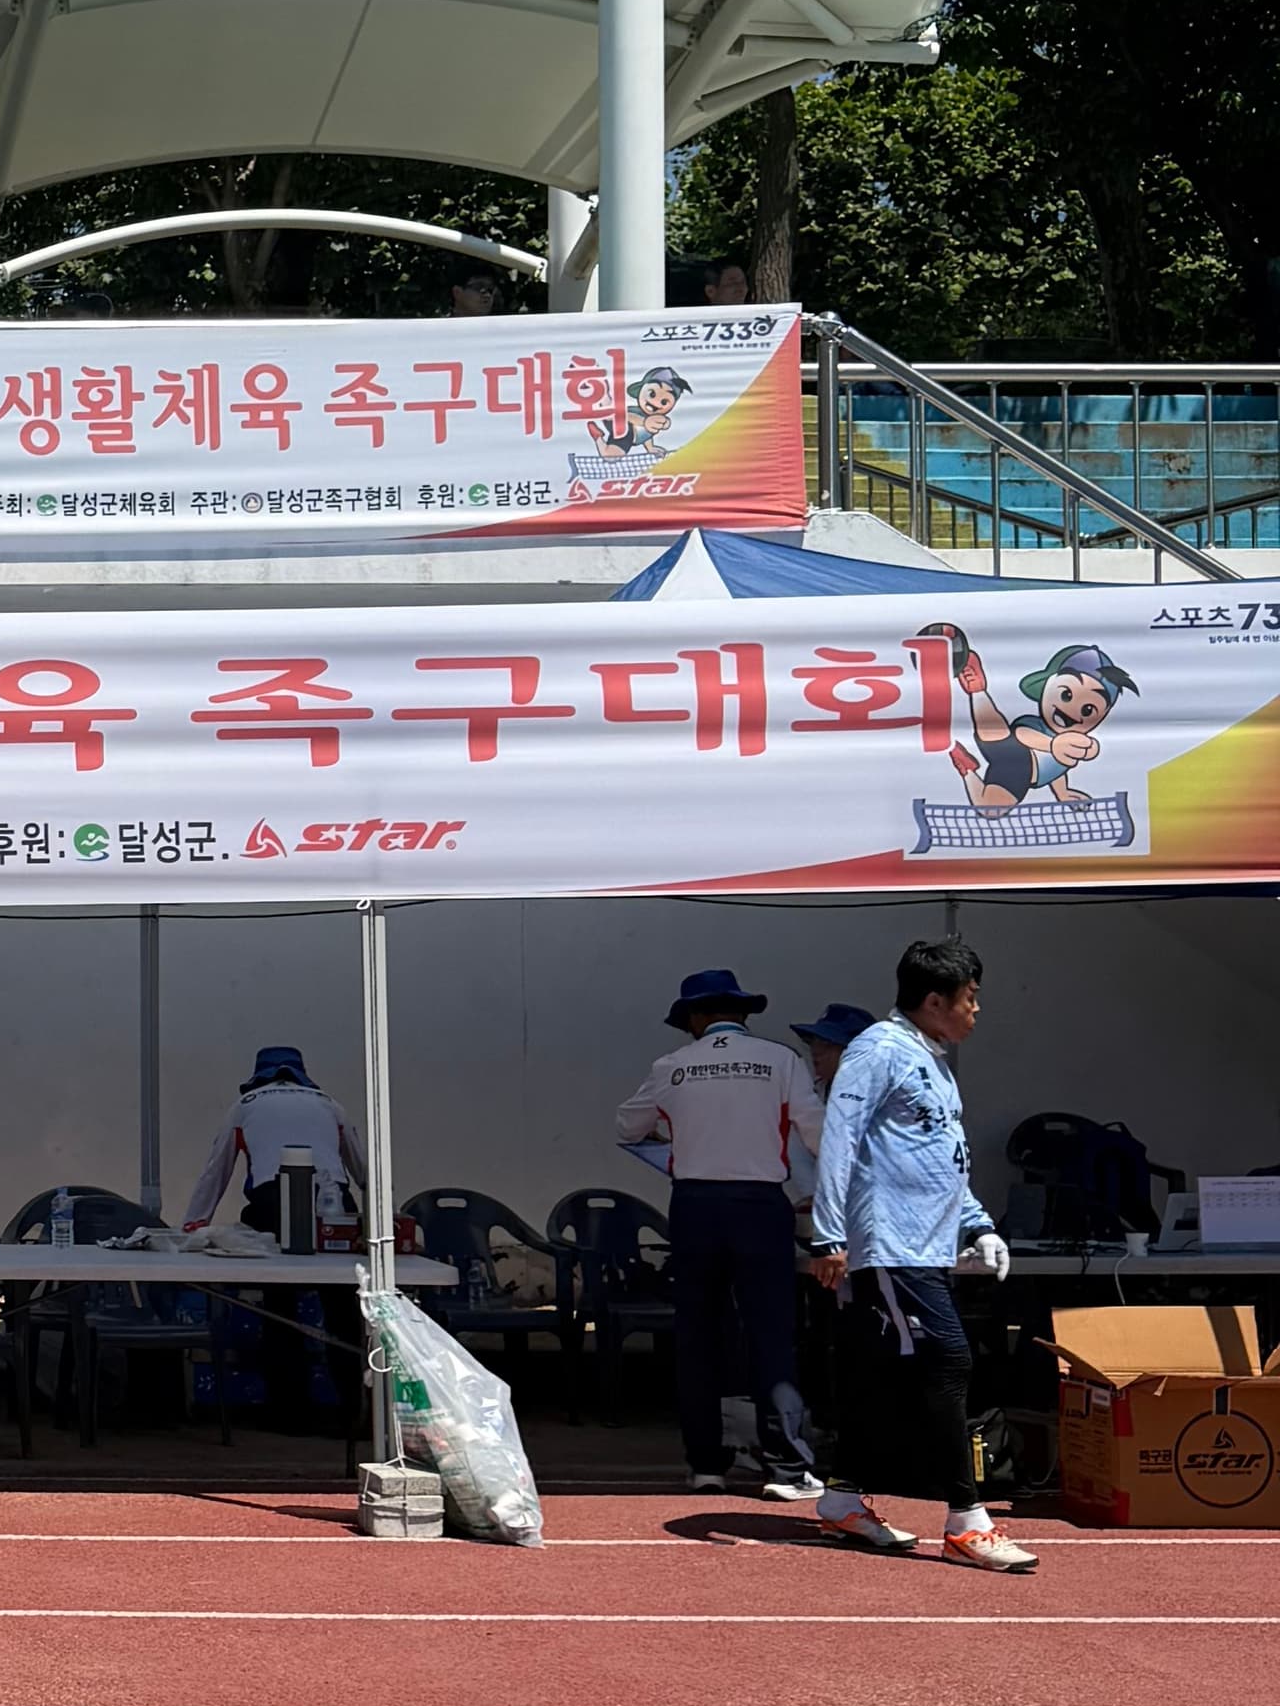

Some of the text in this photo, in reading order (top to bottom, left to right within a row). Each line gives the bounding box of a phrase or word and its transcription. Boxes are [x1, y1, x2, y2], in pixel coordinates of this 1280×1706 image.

[643, 325, 698, 340] 스포츠
[325, 348, 629, 450] 족구대회
[61, 487, 176, 518] 달성군체육회
[190, 487, 239, 515] 주관:
[265, 484, 403, 514] 달성군족구협회
[417, 482, 464, 510] 후원:
[1153, 606, 1231, 626] 스포츠
[190, 636, 958, 768] 족구대회
